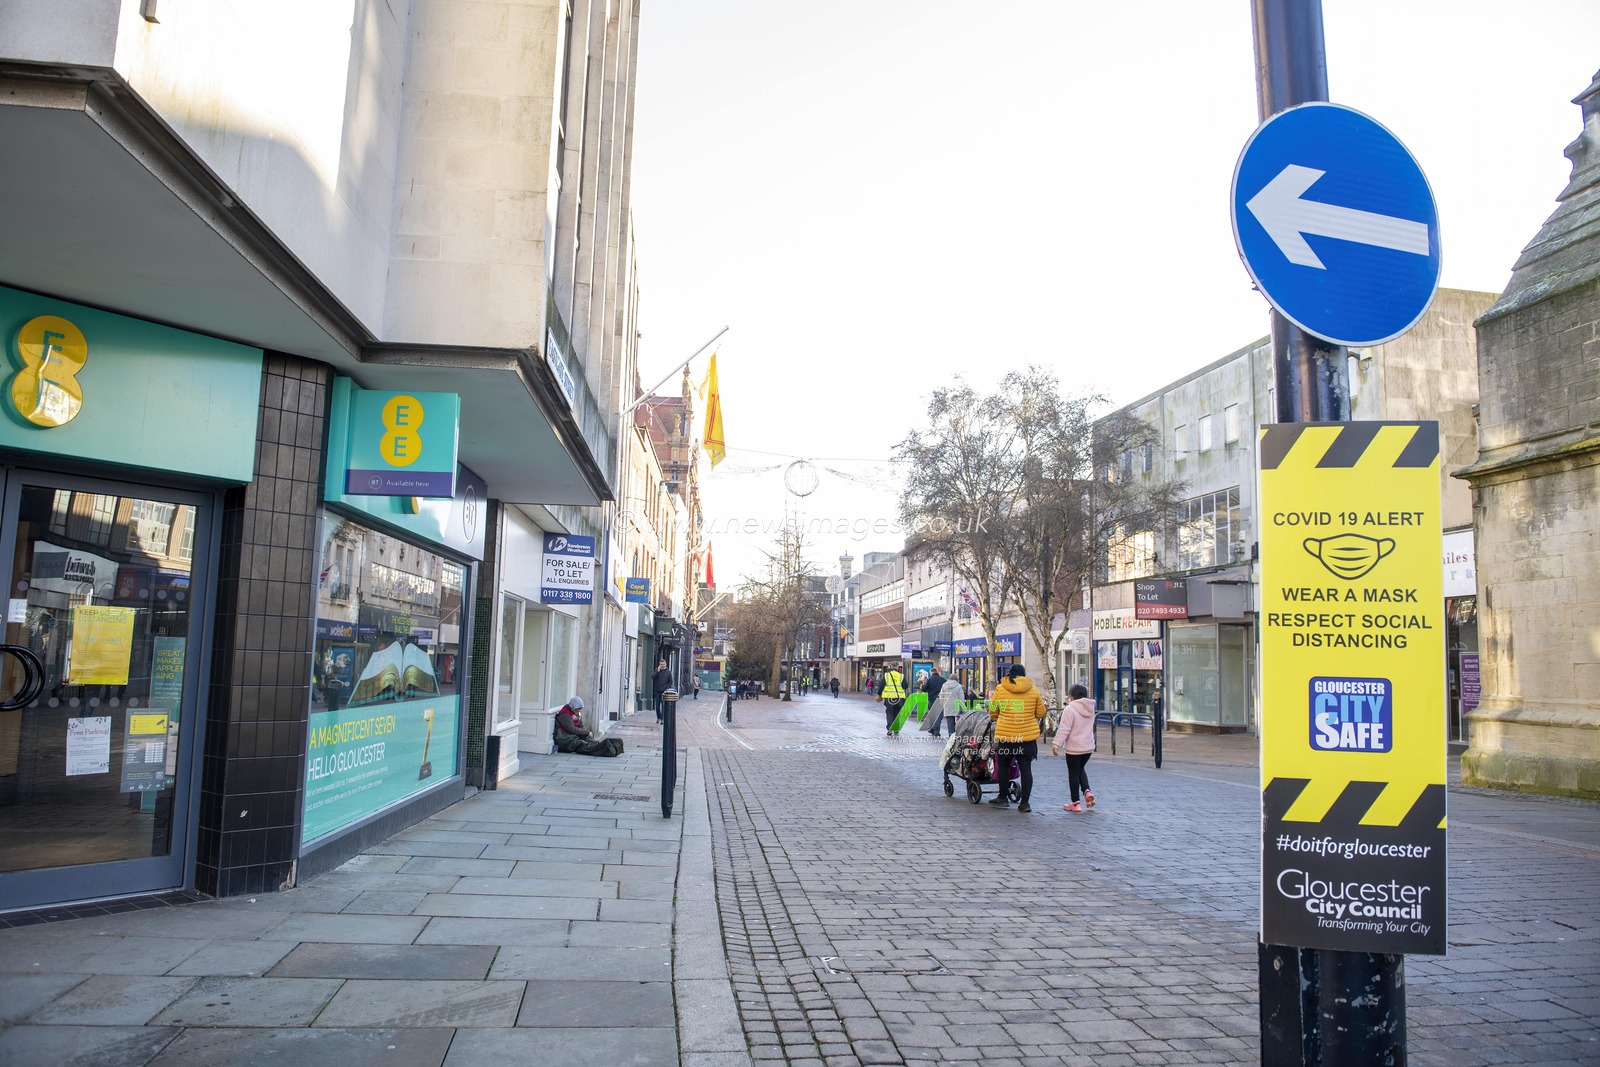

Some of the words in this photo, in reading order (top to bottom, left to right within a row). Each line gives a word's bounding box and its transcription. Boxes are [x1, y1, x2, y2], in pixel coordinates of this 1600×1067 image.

[386, 479, 414, 487] Available
[416, 480, 430, 488] here
[1273, 511, 1332, 527] COVID
[1338, 511, 1358, 526] 19
[1363, 512, 1425, 526] ALERT
[546, 559, 564, 568] FOR
[566, 561, 591, 570] SALE/
[553, 568, 565, 577] TO
[567, 570, 583, 578] LET
[558, 578, 590, 586] ENQUIRIES
[1136, 583, 1155, 591] Shop
[543, 589, 559, 598] 0117
[574, 592, 591, 600] 1800
[1281, 587, 1339, 602] WEAR
[1344, 588, 1358, 602] A
[1363, 588, 1418, 603] MASK
[77, 616, 127, 624] DISTANCING
[1093, 613, 1121, 630] MOBILE
[1122, 616, 1152, 628] REPAIR
[1268, 613, 1356, 628] RESPECT
[1361, 614, 1433, 629] SOCIAL
[1292, 633, 1408, 649] DISTANCING
[157, 649, 181, 657] GREAT
[156, 664, 180, 672] APPLE
[157, 657, 182, 665] MAKES
[155, 672, 175, 680] SING
[1314, 681, 1385, 695] GLOUCESTER
[1315, 693, 1384, 726] CITY
[84, 728, 109, 736] Parking!
[309, 728, 317, 750] A
[318, 719, 375, 748] MAGNIFICENT
[375, 715, 396, 736] SEVEN
[1315, 712, 1384, 749] SAFE
[307, 754, 337, 782] HELLO
[337, 742, 386, 772] GLOUCESTER
[1276, 834, 1431, 859] #doitforgloucester
[1276, 868, 1431, 904] Gloucester
[1305, 899, 1347, 919] City
[1349, 901, 1422, 919] Council
[1316, 916, 1383, 934] Transforming
[1385, 921, 1408, 933] Your
[1410, 922, 1431, 935] City
